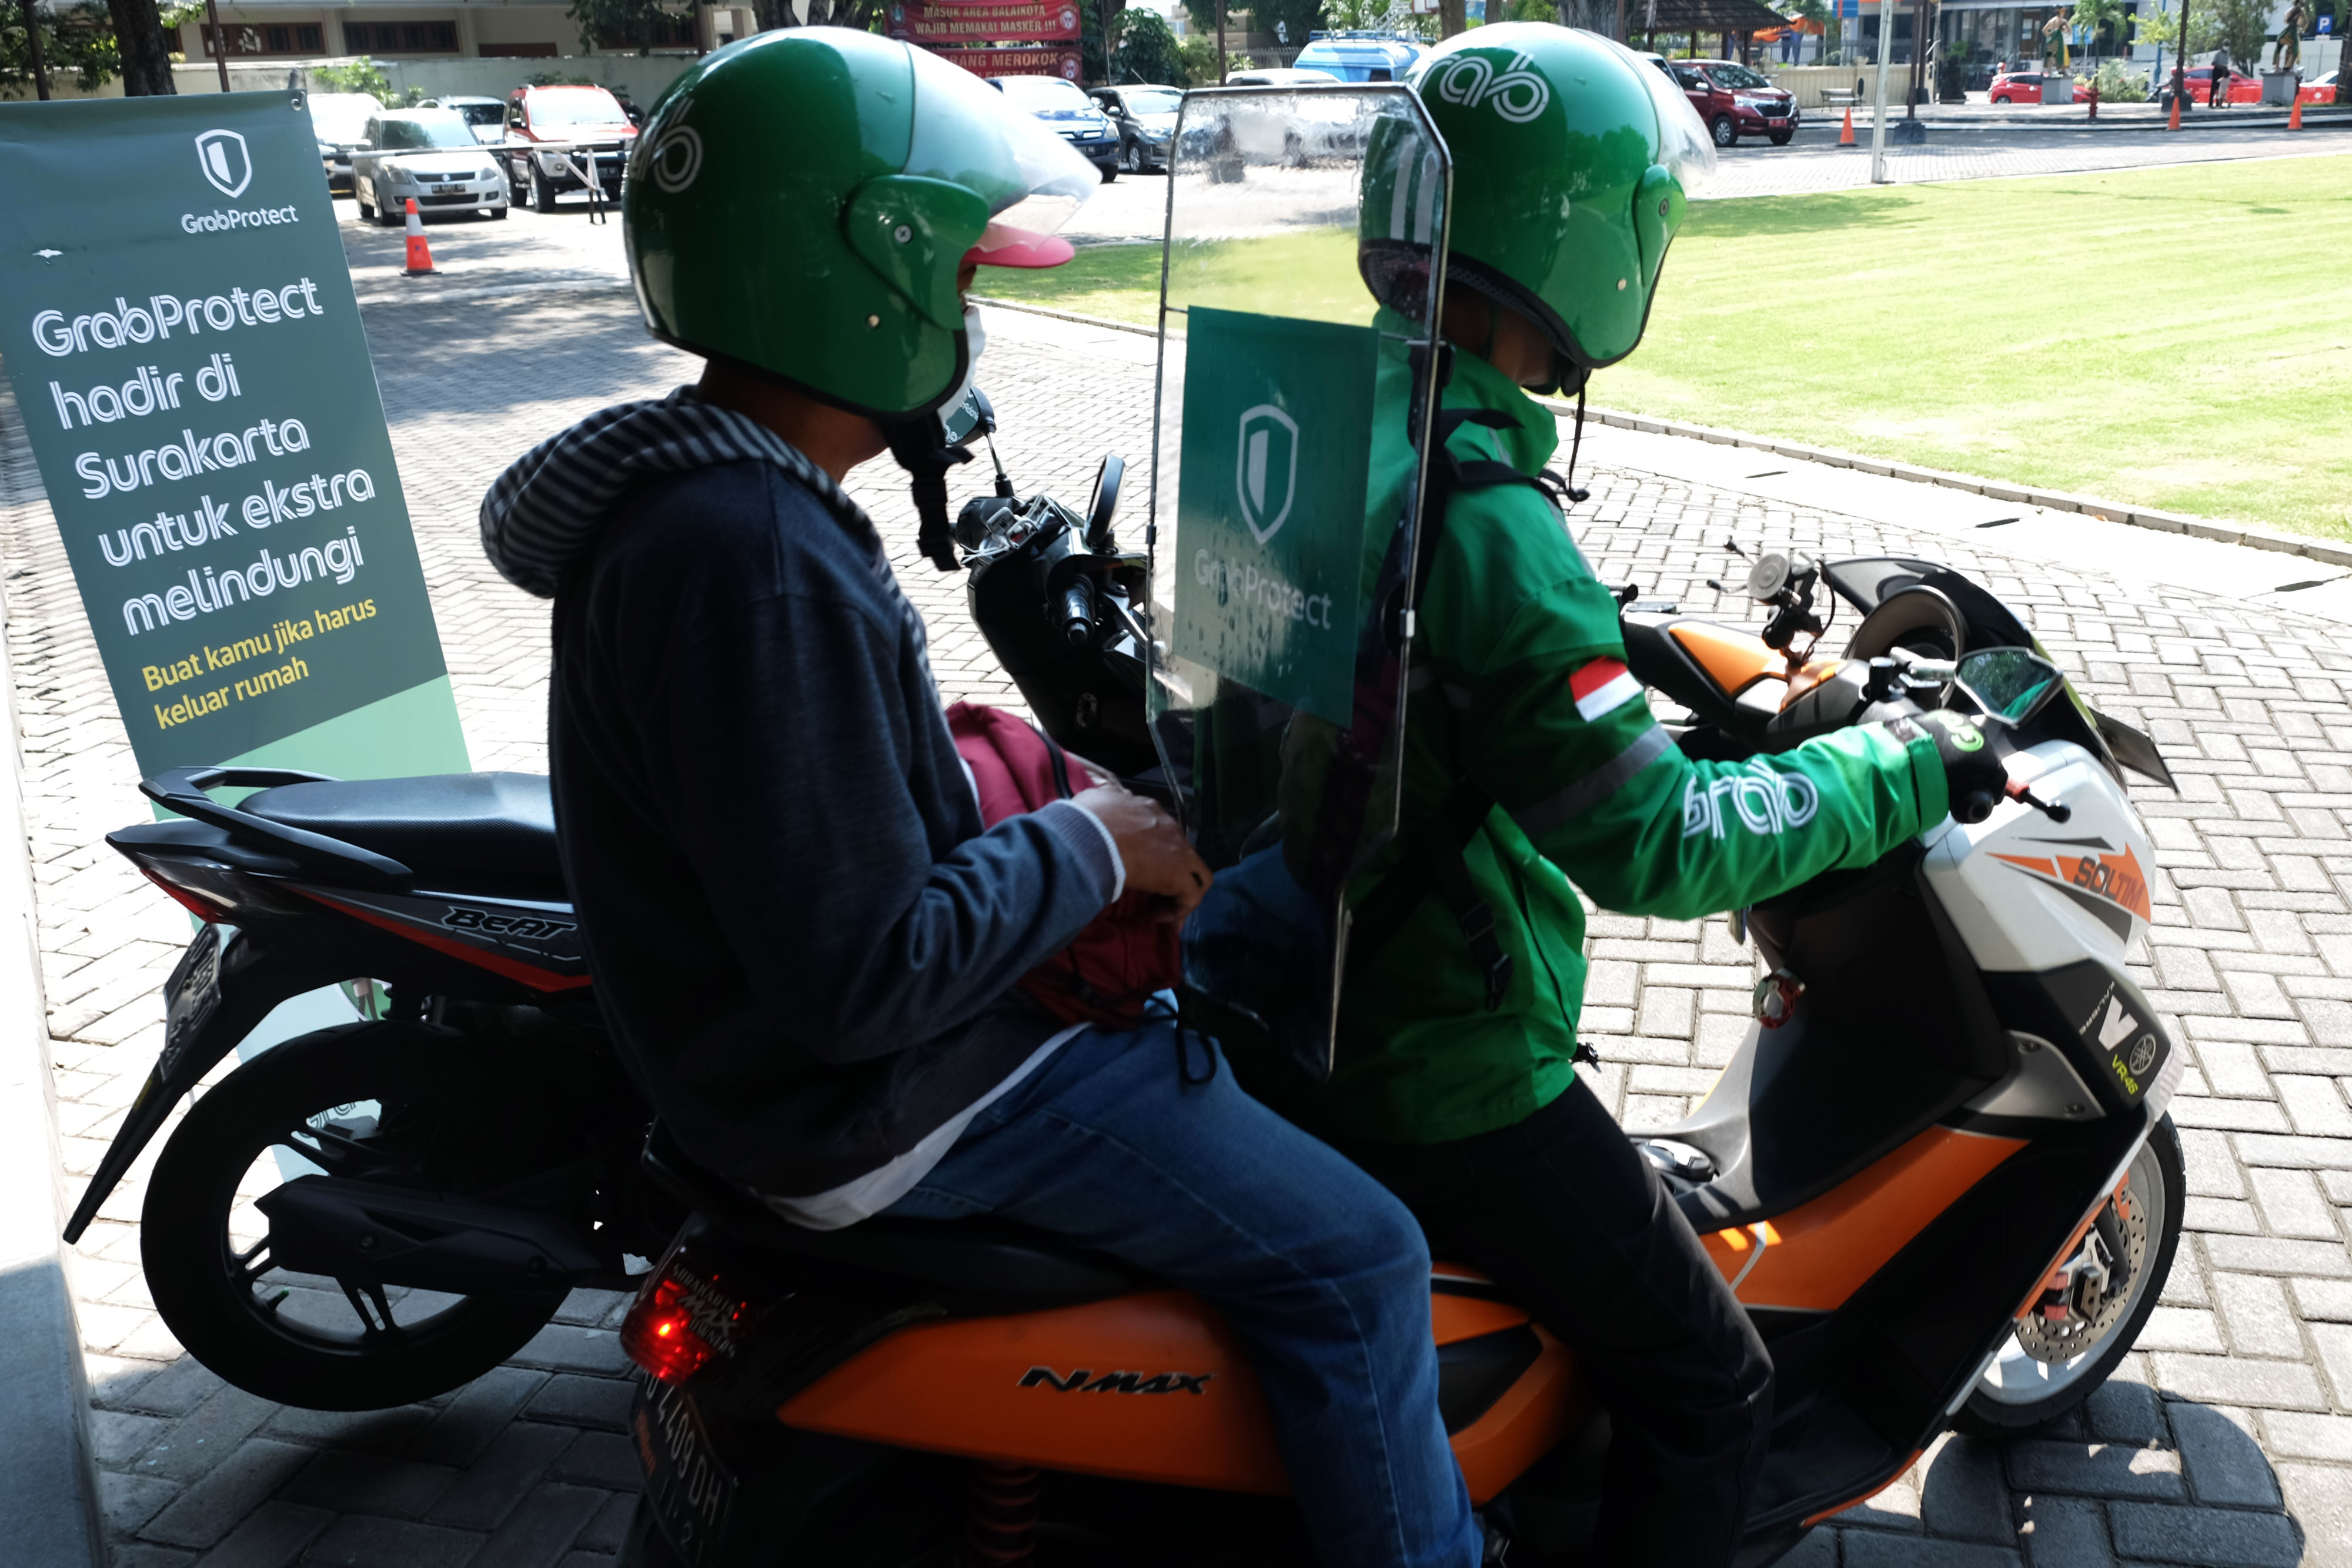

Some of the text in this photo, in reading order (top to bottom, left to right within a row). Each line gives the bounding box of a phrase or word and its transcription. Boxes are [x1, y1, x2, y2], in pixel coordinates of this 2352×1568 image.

[915, 22, 947, 34] WAJIB
[950, 22, 997, 34] MEMAKAI
[1000, 20, 1041, 32] MASKER
[924, 6, 960, 18] MASUK
[963, 6, 988, 18] AREA
[992, 5, 1045, 17] BALAIKOTA
[2319, 17, 2330, 31] P
[943, 54, 987, 66] RANG
[991, 53, 1058, 66] MEROKOK
[1403, 51, 1550, 123] rab
[181, 205, 299, 234] GrabProtect
[32, 276, 324, 357] GrabProtect
[49, 353, 241, 430] hadir di
[75, 418, 311, 499] Surakarta
[98, 469, 376, 567] untuk ekstra
[122, 525, 365, 636] melindungi
[142, 598, 377, 691] Buat kamu jika harus
[153, 656, 309, 730] keluar rumah
[2097, 994, 2139, 1052] V
[2112, 1053, 2139, 1095] VR46
[1016, 1365, 1220, 1395] NMAX
